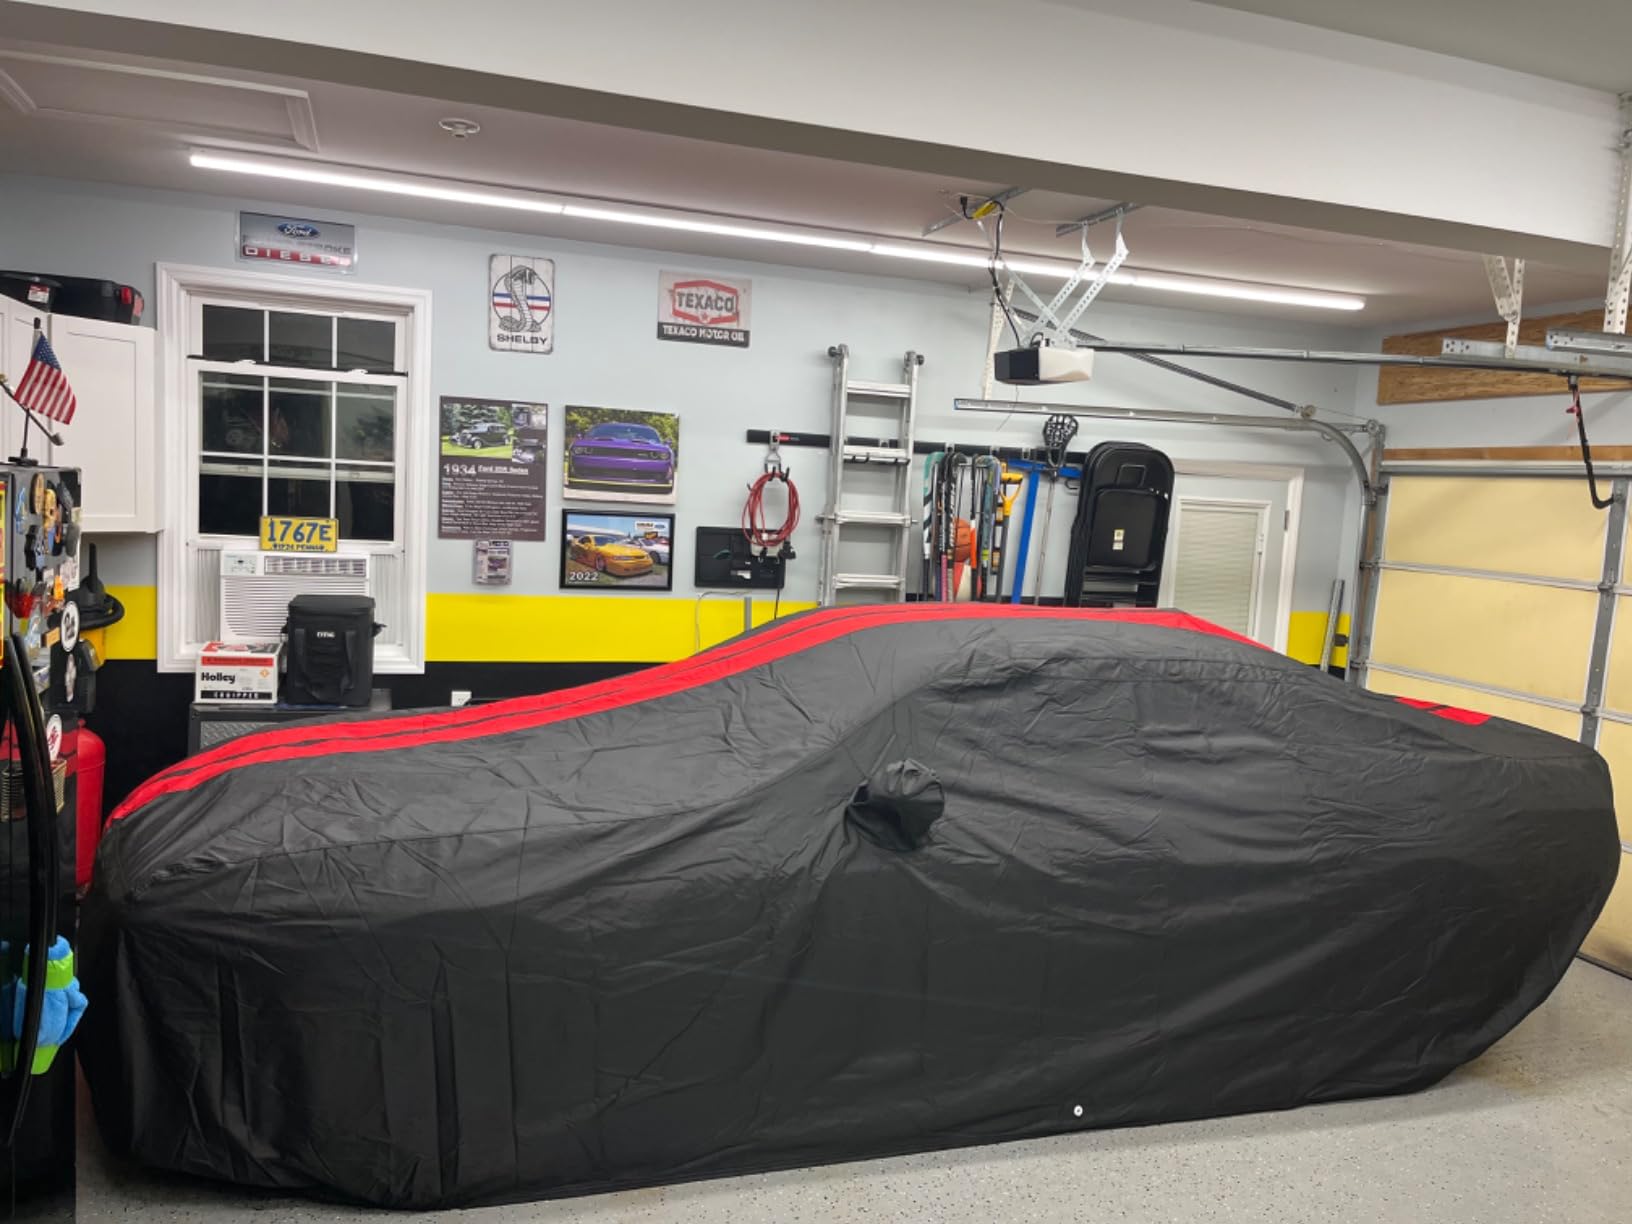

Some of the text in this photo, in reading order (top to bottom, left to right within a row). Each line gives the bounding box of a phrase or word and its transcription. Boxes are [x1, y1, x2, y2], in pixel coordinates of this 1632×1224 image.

[284, 224, 312, 236] Ford
[677, 291, 735, 313] TEXACO
[496, 333, 548, 345] SHELBY
[662, 324, 745, 342] TEXACO MOTOR OIL
[443, 463, 477, 477] 1934
[268, 519, 332, 544] 1767E
[569, 571, 599, 581] 2022
[201, 672, 236, 685] Holley
